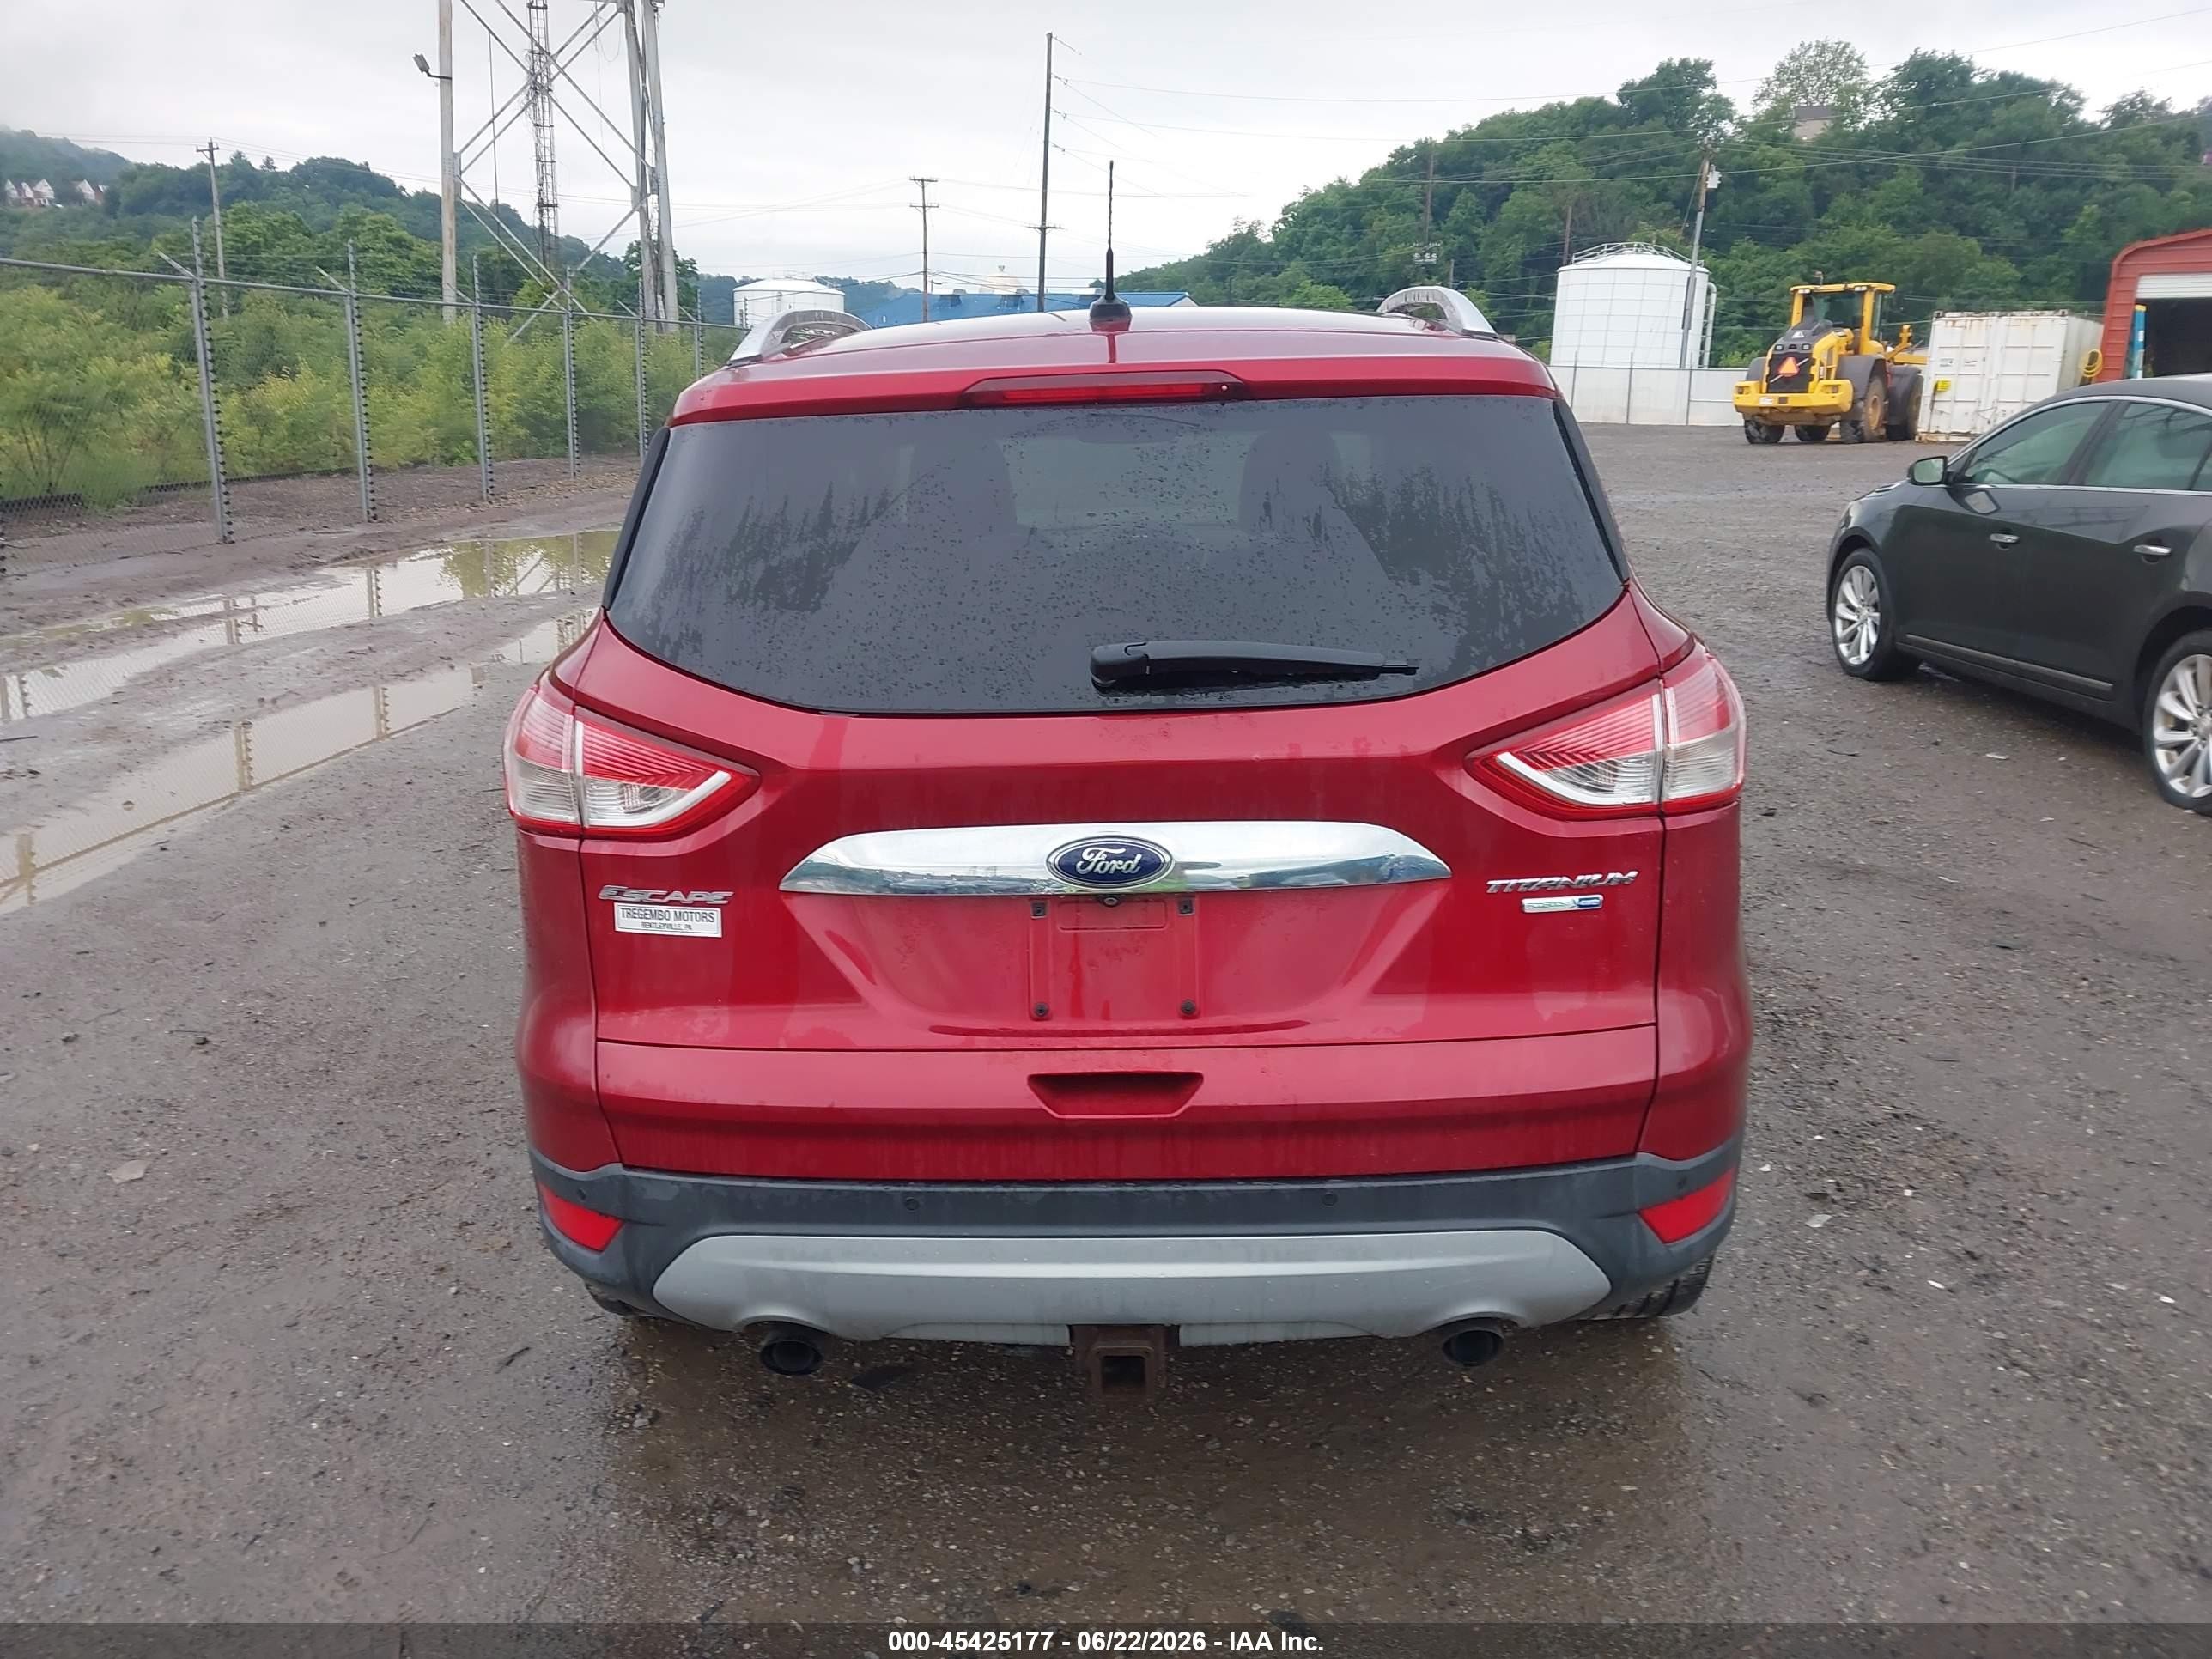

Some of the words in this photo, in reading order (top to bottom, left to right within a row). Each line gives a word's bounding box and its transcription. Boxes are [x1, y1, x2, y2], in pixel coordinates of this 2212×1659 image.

[1075, 847, 1143, 875] Ford
[1486, 871, 1639, 893] TITANIUM
[598, 884, 734, 904] ESCAPE
[620, 907, 671, 921] TREGEMBO
[673, 910, 715, 923] MOTORS
